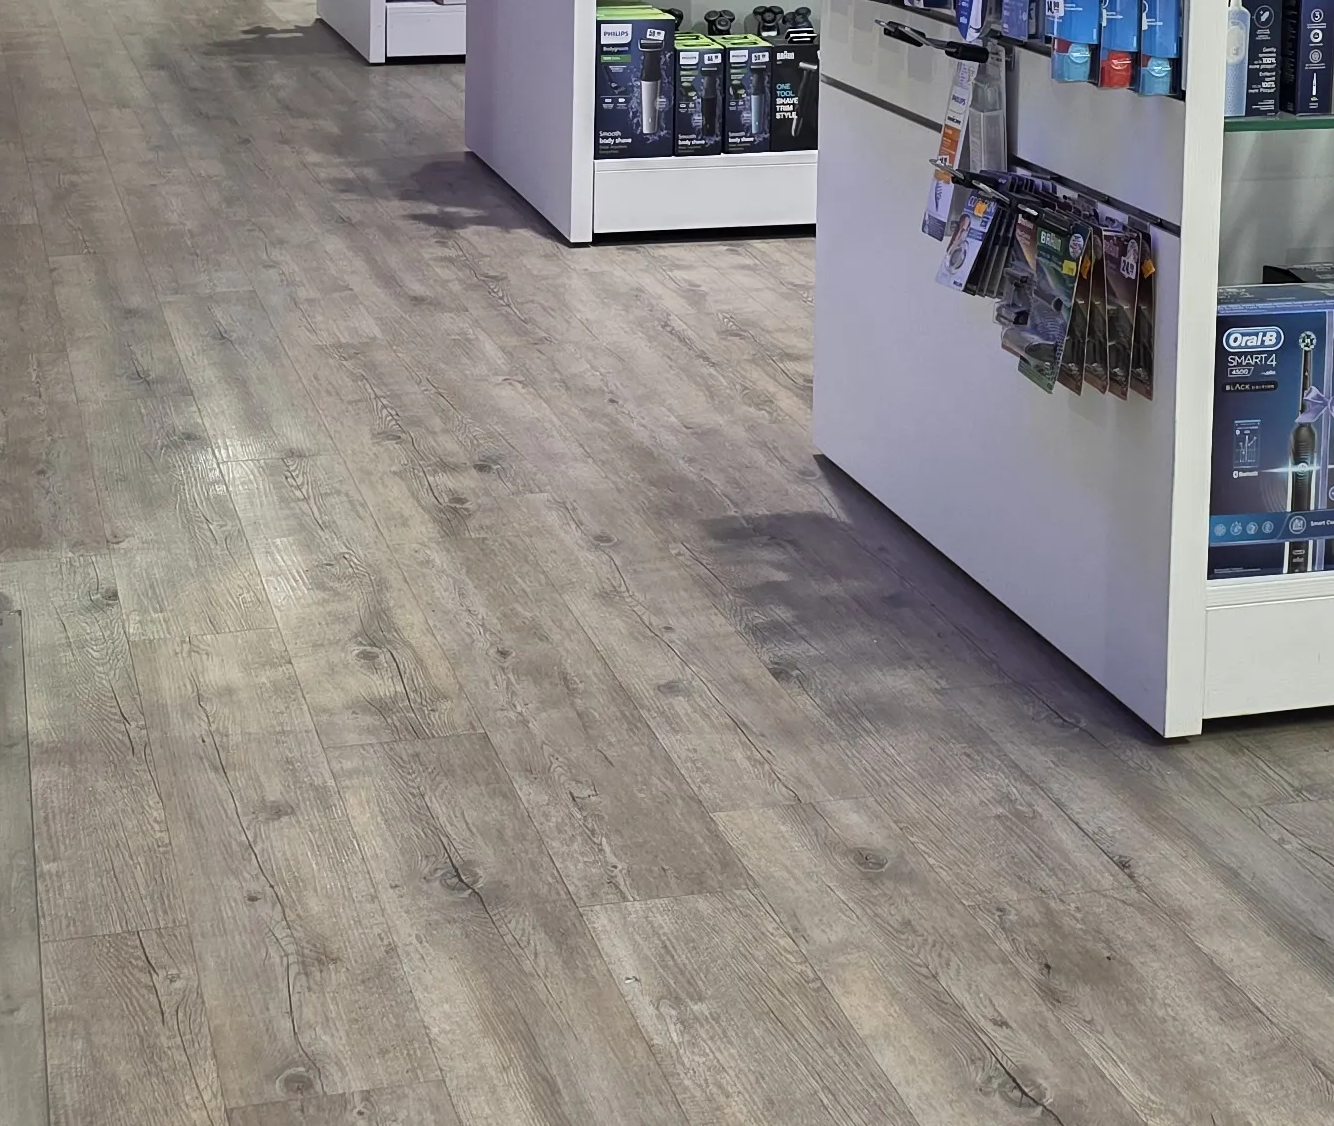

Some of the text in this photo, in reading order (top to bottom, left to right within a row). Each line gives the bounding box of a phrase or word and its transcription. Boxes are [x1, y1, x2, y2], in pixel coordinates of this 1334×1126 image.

[603, 30, 629, 39] PHILIPS
[776, 82, 791, 91] ONE
[775, 97, 799, 105] SHAVE
[776, 105, 794, 113] TRIM
[599, 130, 622, 138] Smooth
[678, 133, 697, 141] Smooth
[1040, 230, 1062, 252] BRAUN
[1228, 332, 1278, 347] Oral-B
